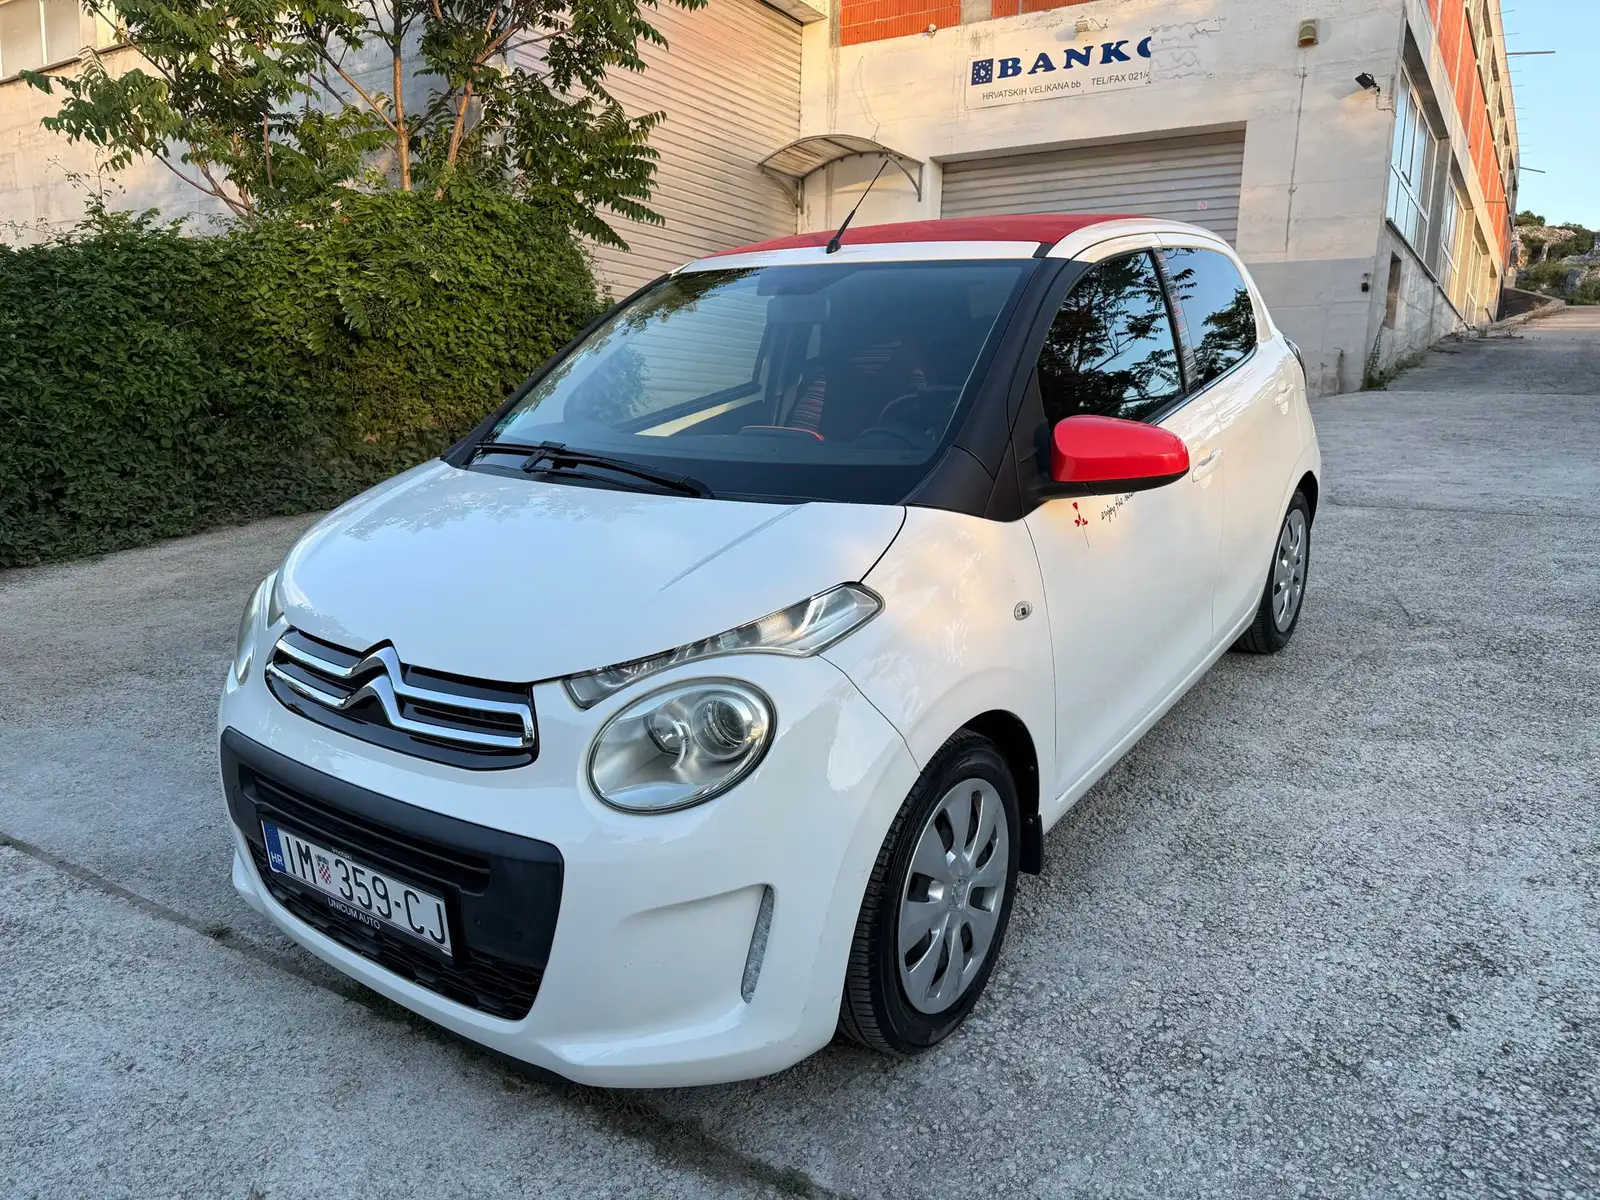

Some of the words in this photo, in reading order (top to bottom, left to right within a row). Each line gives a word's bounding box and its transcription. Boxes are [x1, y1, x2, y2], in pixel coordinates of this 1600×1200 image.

[982, 88, 1027, 100] HRVATSKIH
[1029, 83, 1070, 95] VELIKANA
[1071, 80, 1081, 89] bb
[1091, 74, 1126, 86] TEL/FAX
[270, 851, 284, 866] HR
[285, 835, 318, 884] IM
[335, 858, 446, 944] 359-CJ
[327, 897, 358, 919] UNICUM
[358, 914, 381, 930] AUTO
